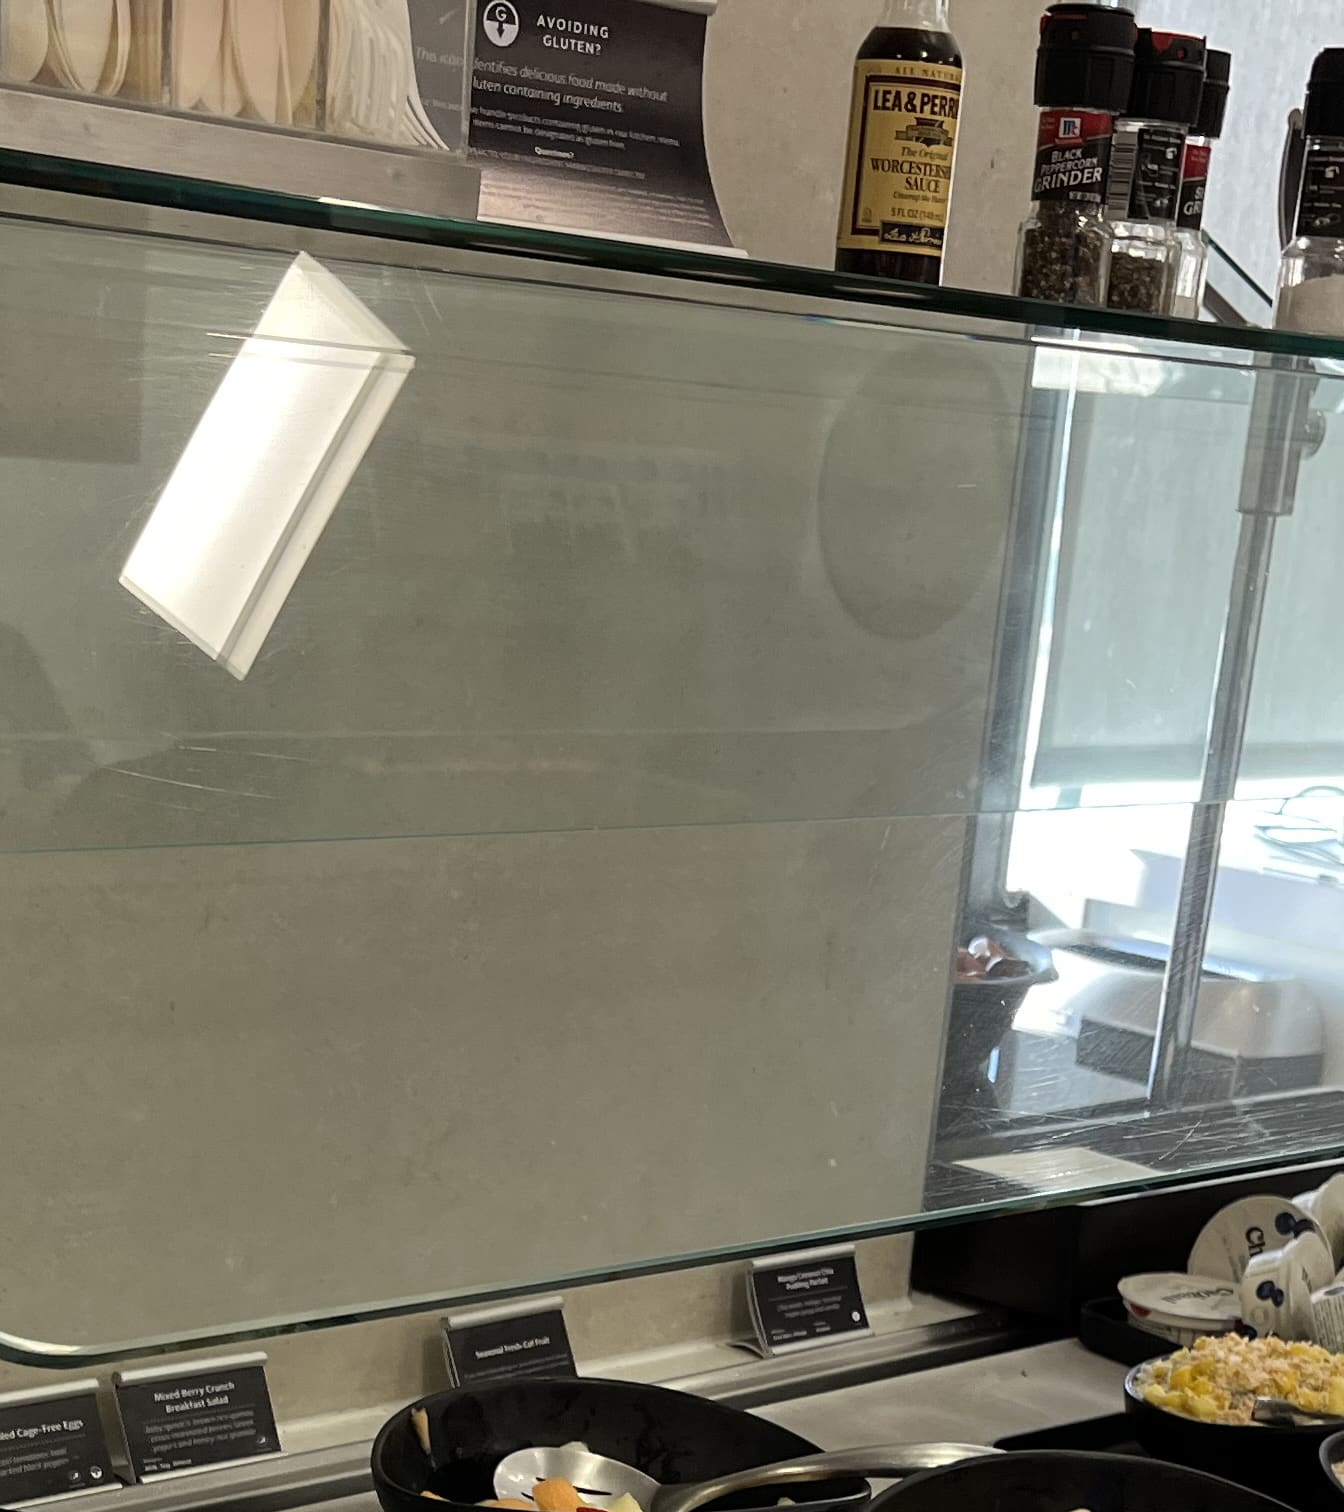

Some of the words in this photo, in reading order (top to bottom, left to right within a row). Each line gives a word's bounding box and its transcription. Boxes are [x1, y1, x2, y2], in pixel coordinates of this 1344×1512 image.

[537, 14, 609, 38] AVOIDING
[543, 35, 601, 55] GLUTEN?
[473, 57, 517, 76] entifies
[520, 66, 566, 84] delicious
[569, 73, 593, 88] food
[595, 80, 626, 95] made
[627, 87, 668, 102] without
[472, 75, 501, 92] luten
[503, 83, 560, 106] containing
[873, 89, 902, 112] LEA
[904, 91, 917, 113] &
[1040, 156, 1098, 176] PEPPERCORN
[1051, 148, 1083, 163] BLACK
[870, 157, 951, 180] WORCESTERS
[904, 176, 940, 193] SAUCE
[1034, 167, 1102, 192] GRINDER
[153, 1388, 181, 1402] Mixed
[181, 1386, 205, 1399] Berry
[205, 1381, 235, 1394] Crunch
[165, 1400, 206, 1414] Breakfast
[206, 1395, 229, 1408] Salad
[16, 1423, 62, 1439] Cage-Free
[62, 1418, 84, 1432] Eggs
